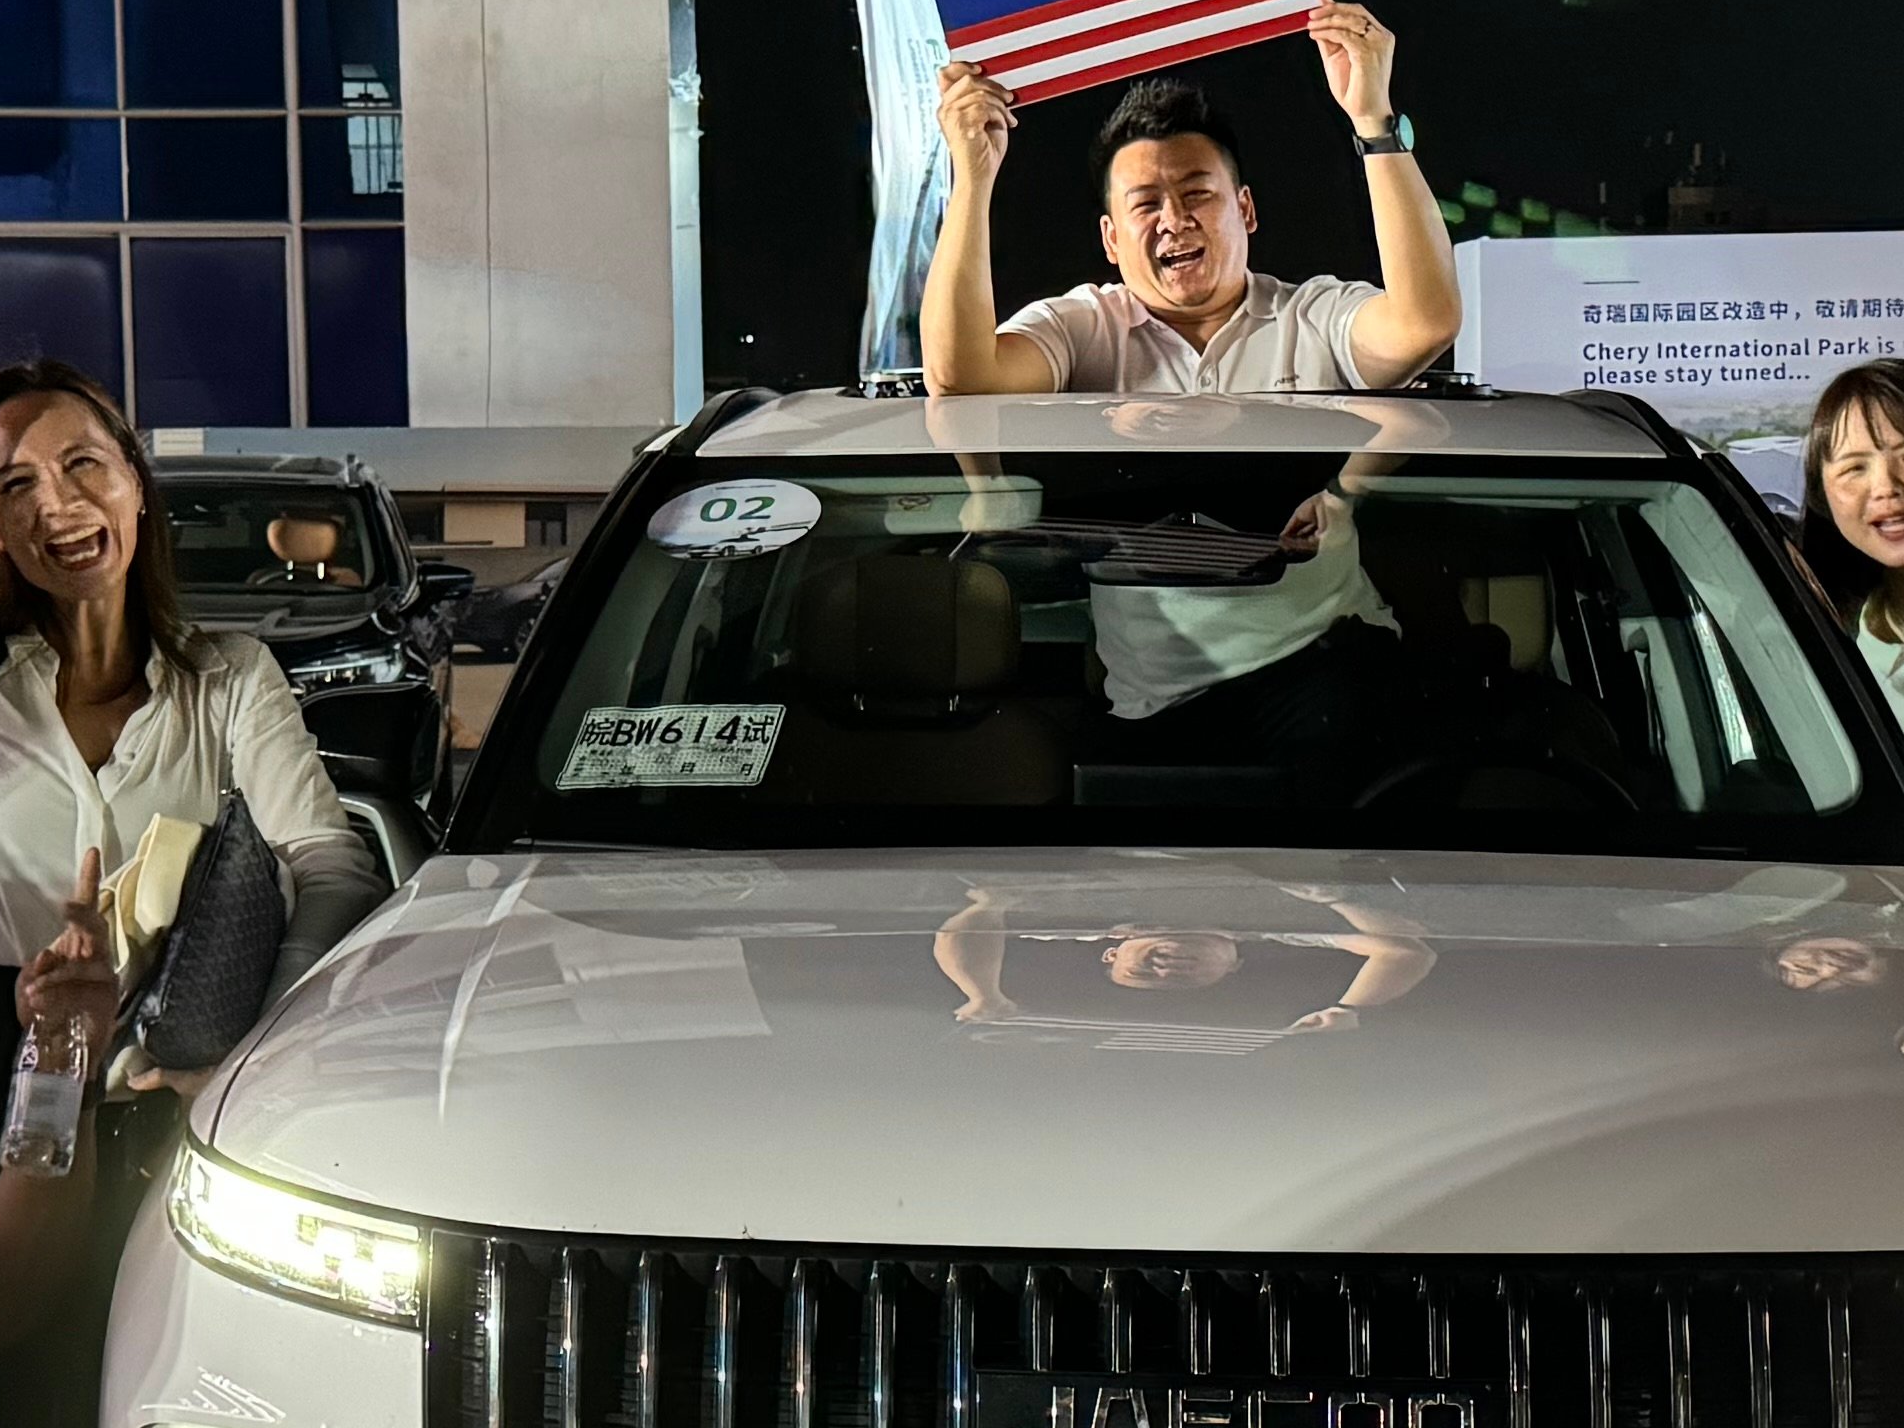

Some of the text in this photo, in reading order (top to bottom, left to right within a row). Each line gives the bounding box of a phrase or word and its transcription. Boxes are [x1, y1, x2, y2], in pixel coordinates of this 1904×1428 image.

[1582, 342, 1649, 364] Chery
[1657, 337, 1810, 359] International
[1818, 337, 1870, 356] Park
[1877, 335, 1895, 354] is
[1583, 362, 1811, 390] please stay tuned...
[699, 496, 776, 523] 02
